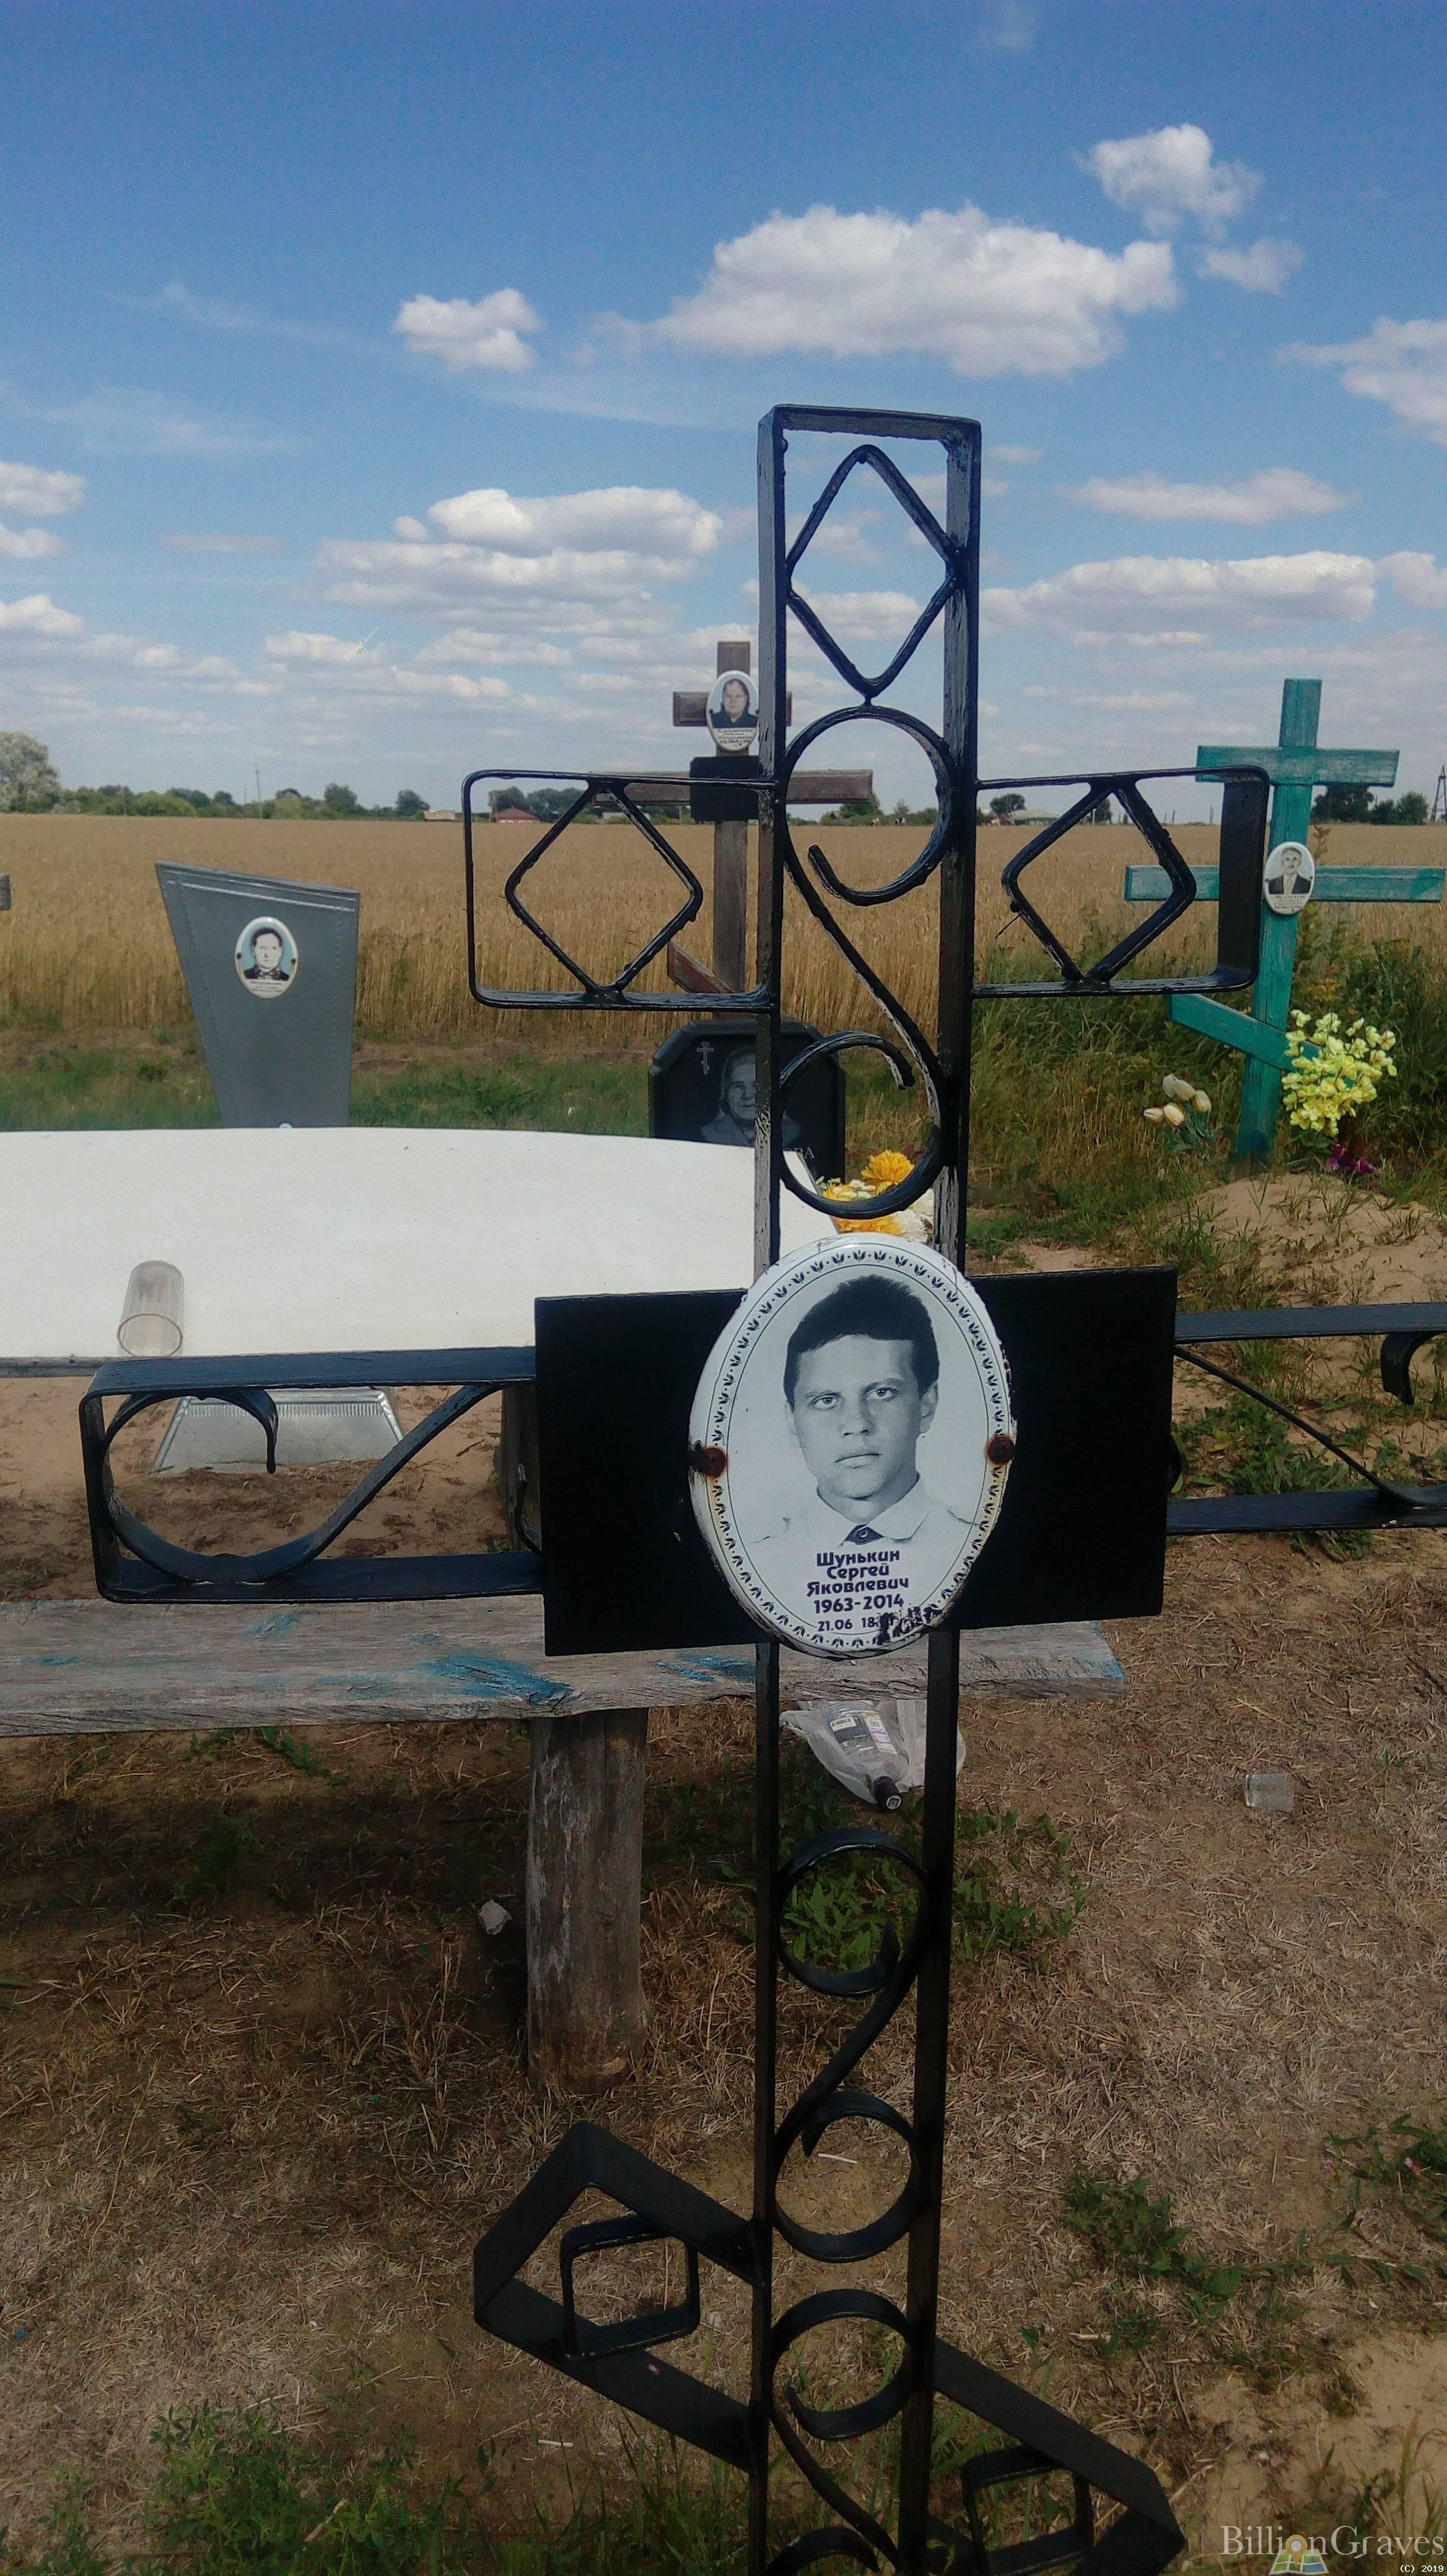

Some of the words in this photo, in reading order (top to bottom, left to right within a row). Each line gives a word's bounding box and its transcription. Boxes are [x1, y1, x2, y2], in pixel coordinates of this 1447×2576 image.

[816, 1550, 900, 1567] Шунькин
[826, 1562, 890, 1581] Сергей
[806, 1578, 909, 1597] Яковлевич
[813, 1593, 904, 1614] 1963-2014
[818, 1618, 853, 1632] 21.06
